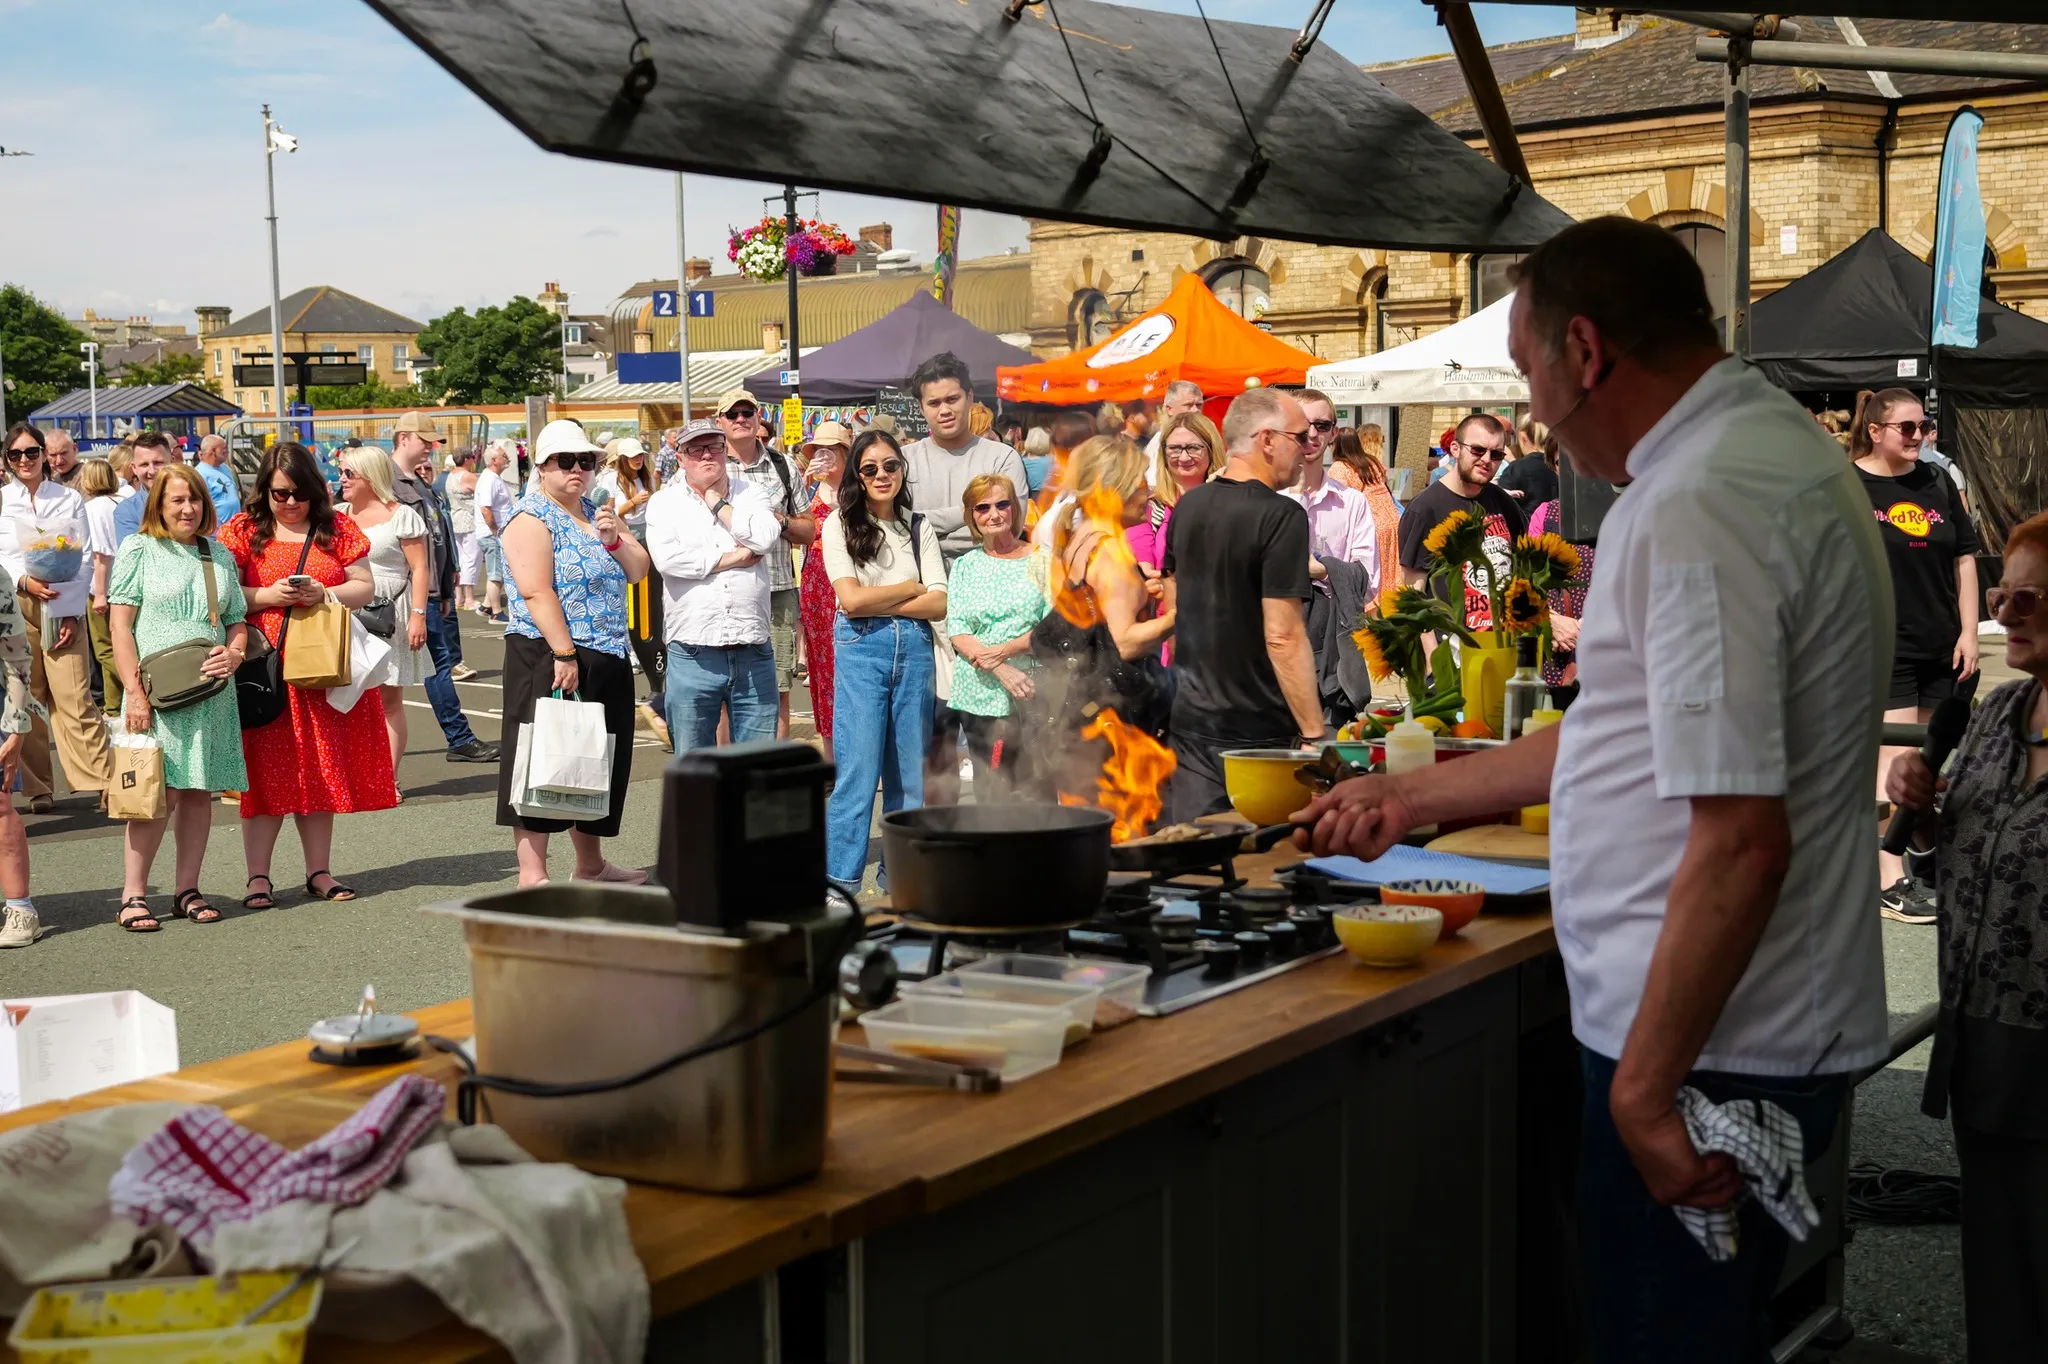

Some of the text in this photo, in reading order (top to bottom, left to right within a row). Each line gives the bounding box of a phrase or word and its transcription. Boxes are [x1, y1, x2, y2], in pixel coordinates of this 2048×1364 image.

[659, 292, 673, 315] 2
[695, 293, 706, 315] 1
[1309, 375, 1366, 388] Bee Natural
[1443, 368, 1497, 382] Handmade
[1499, 369, 1509, 379] in
[1907, 508, 1944, 525] Rock
